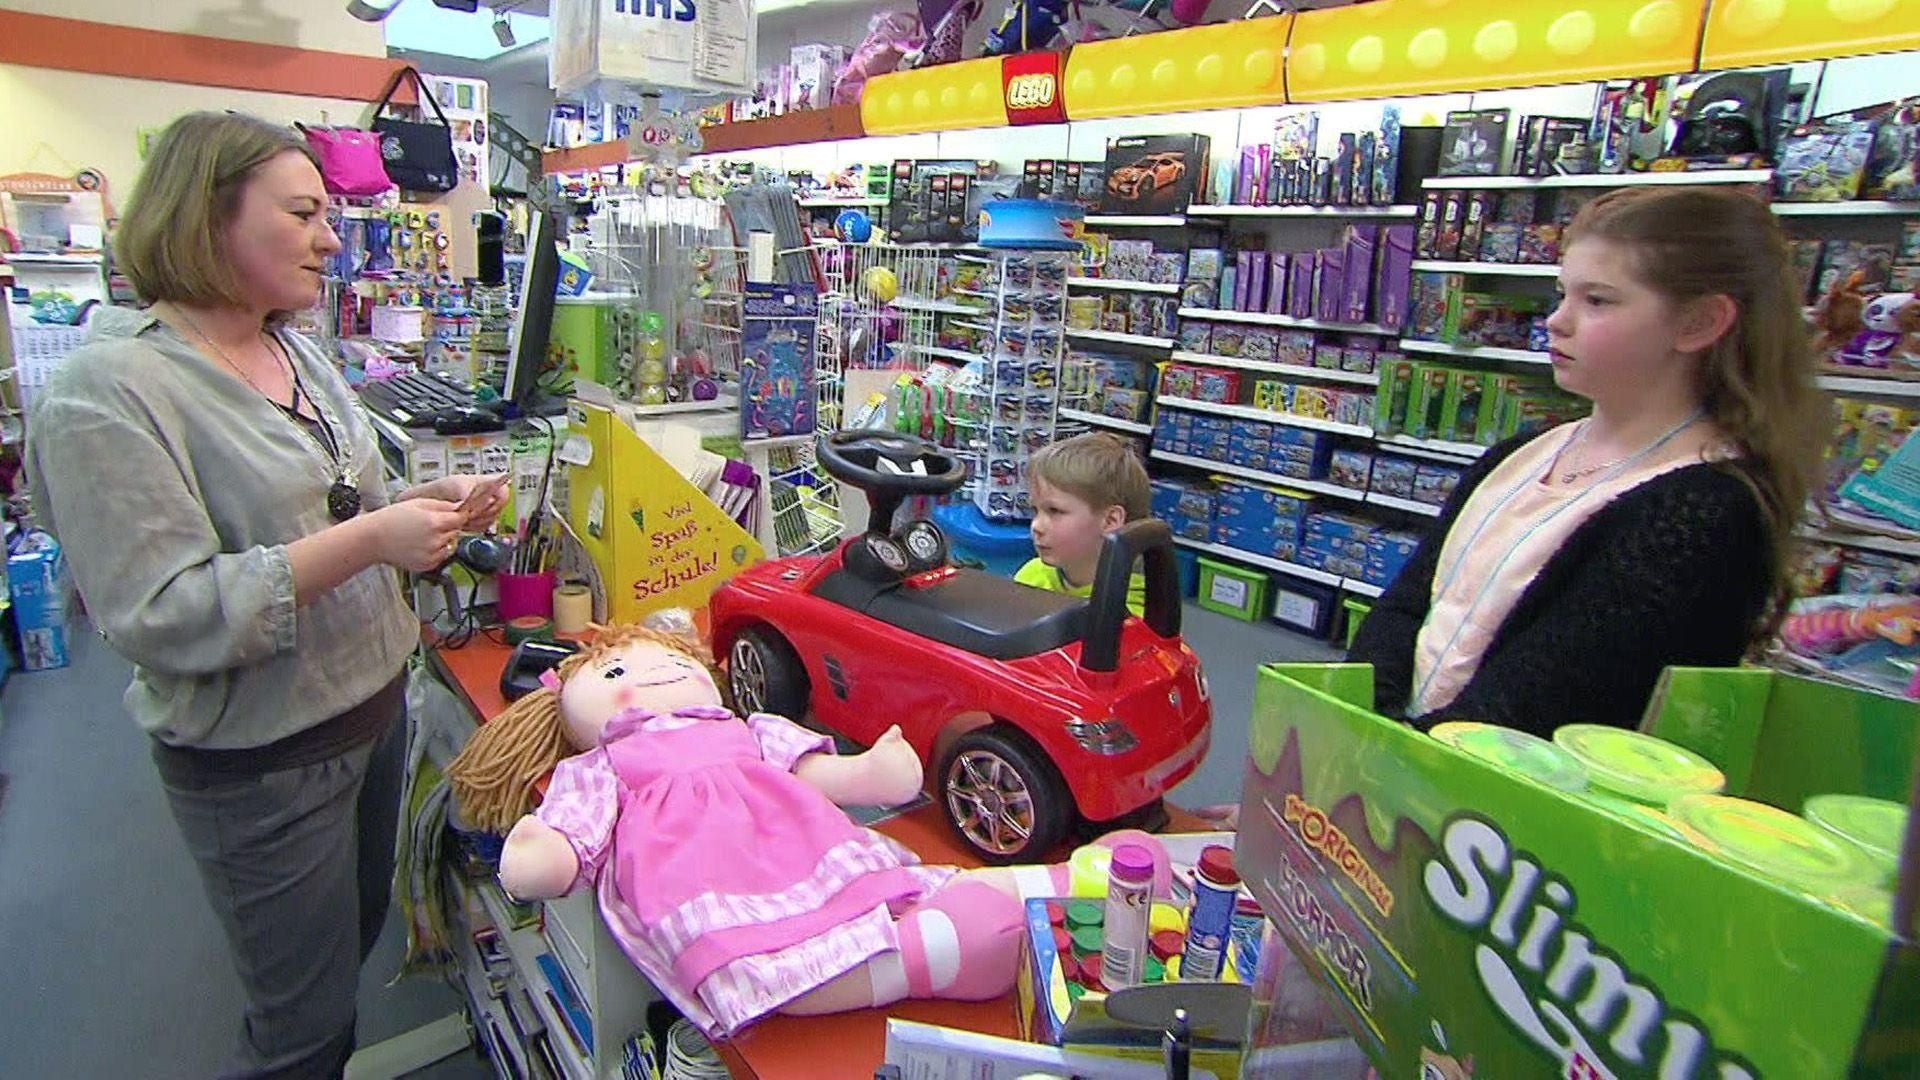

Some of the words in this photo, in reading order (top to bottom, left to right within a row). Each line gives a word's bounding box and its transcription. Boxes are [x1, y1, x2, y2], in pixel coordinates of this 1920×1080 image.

[1007, 74, 1055, 109] LEGO
[663, 501, 692, 519] Viel
[650, 520, 698, 549] Spaß
[648, 554, 665, 567] in
[671, 549, 693, 563] der
[633, 551, 718, 600] Schule!
